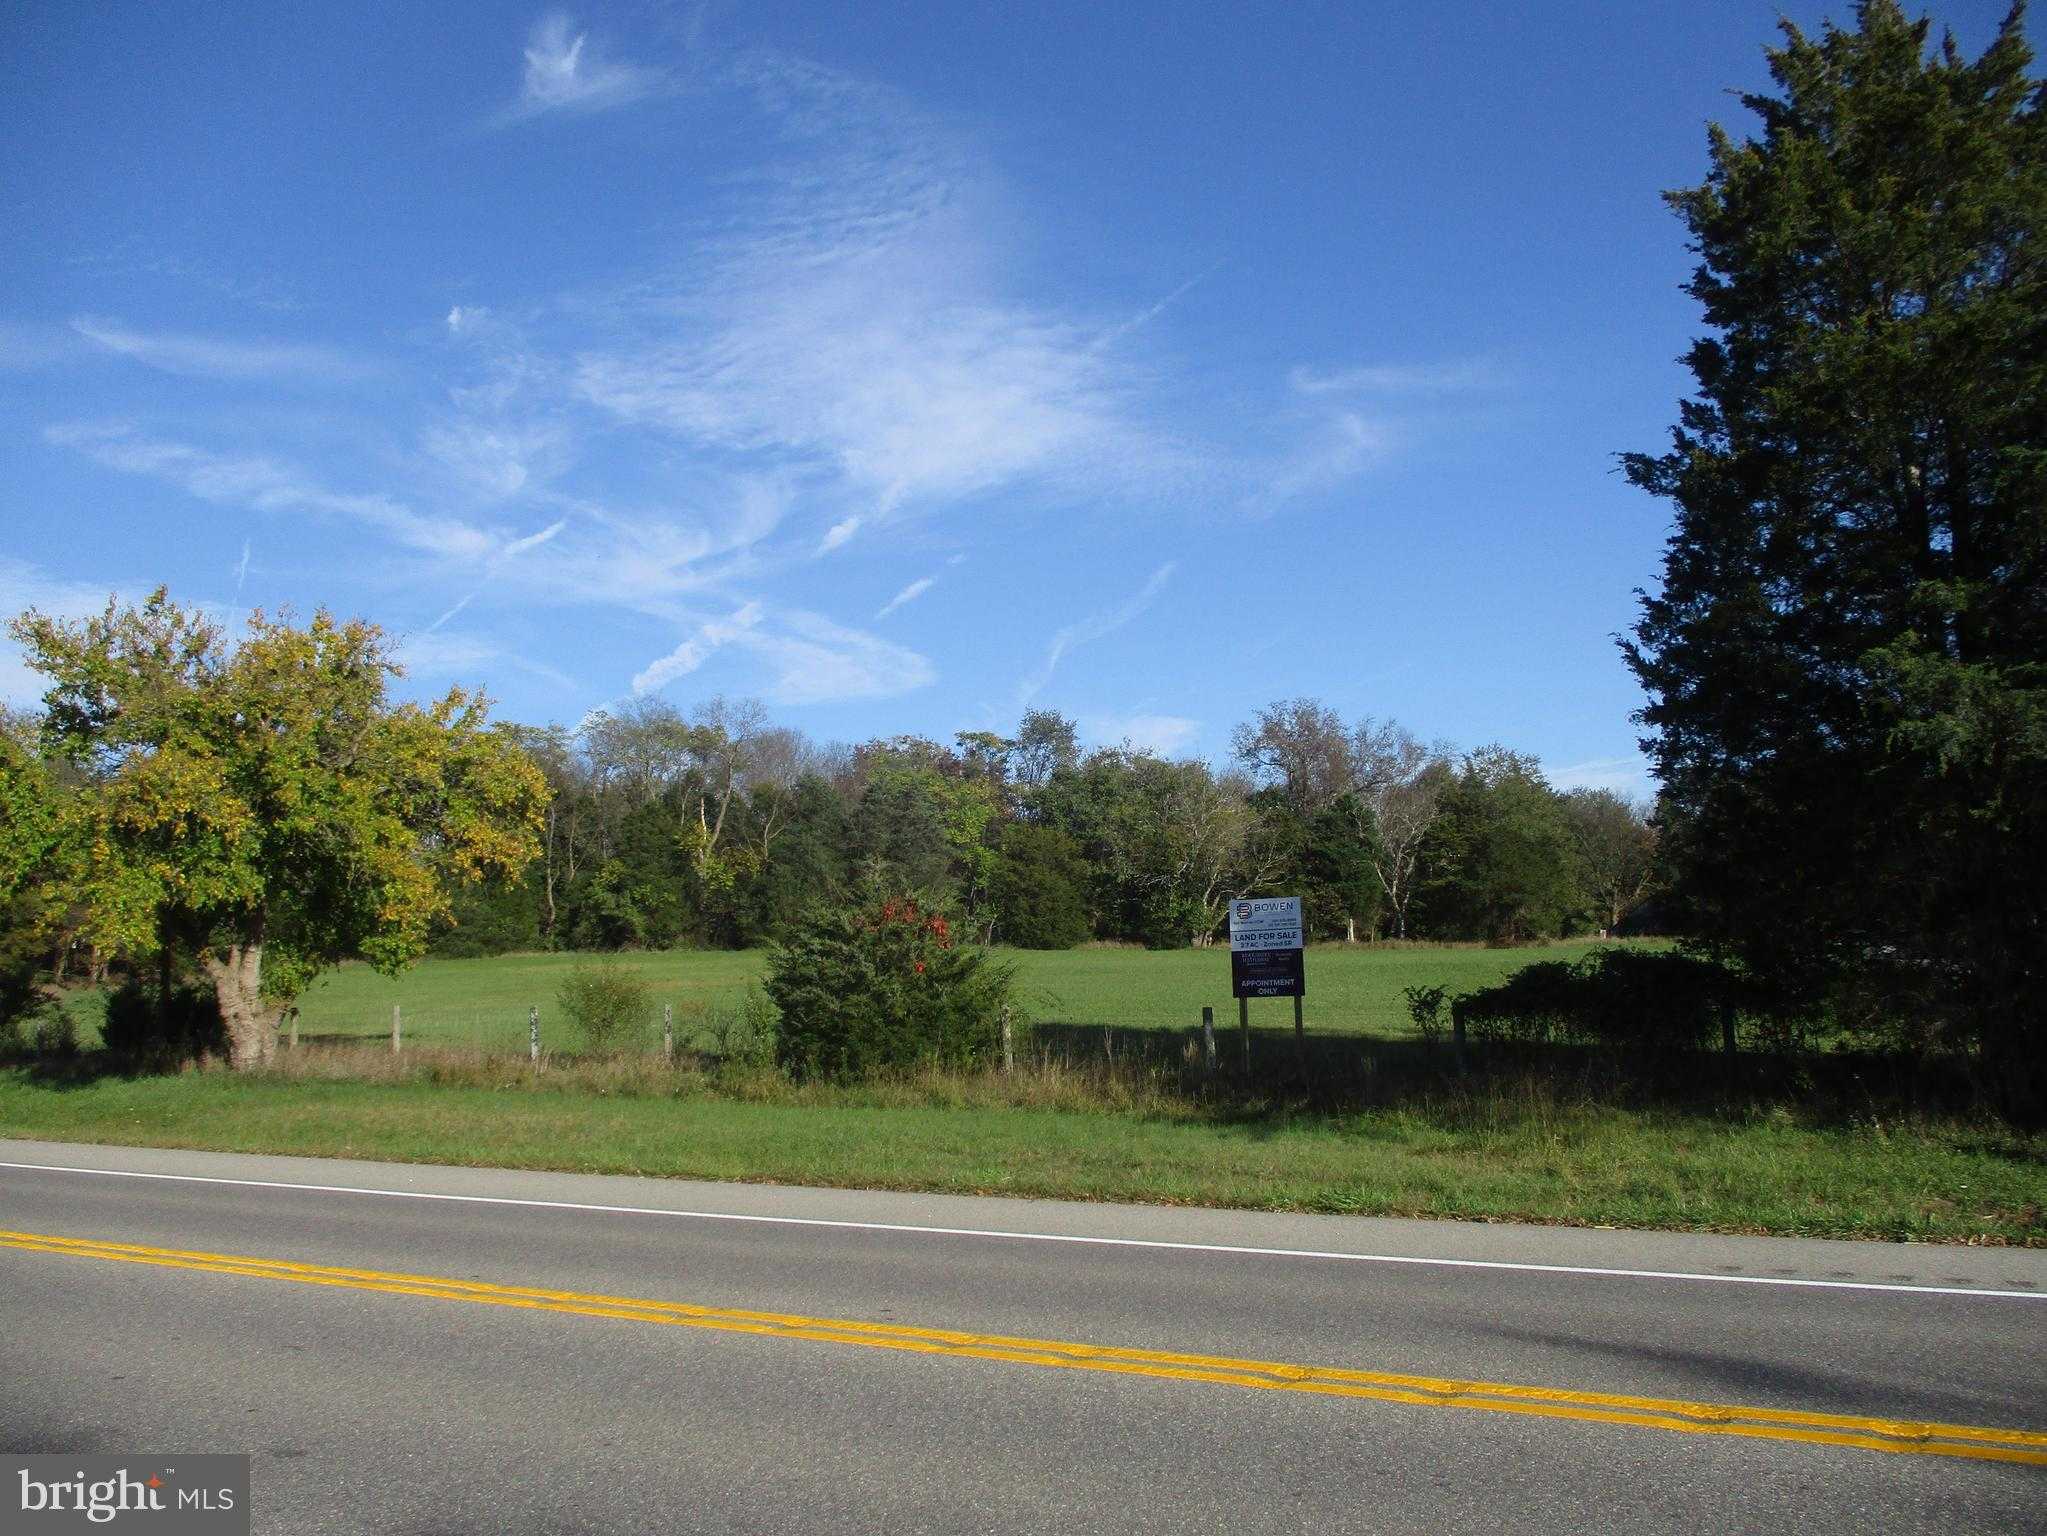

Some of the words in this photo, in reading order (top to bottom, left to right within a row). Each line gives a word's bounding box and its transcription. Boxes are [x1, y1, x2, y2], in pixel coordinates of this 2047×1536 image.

[1254, 902, 1293, 912] BOWEN
[1234, 934, 1256, 942] LAND
[1258, 932, 1275, 940] FOR
[1277, 931, 1297, 939] SALE
[1241, 978, 1294, 987] APPOINTMENT
